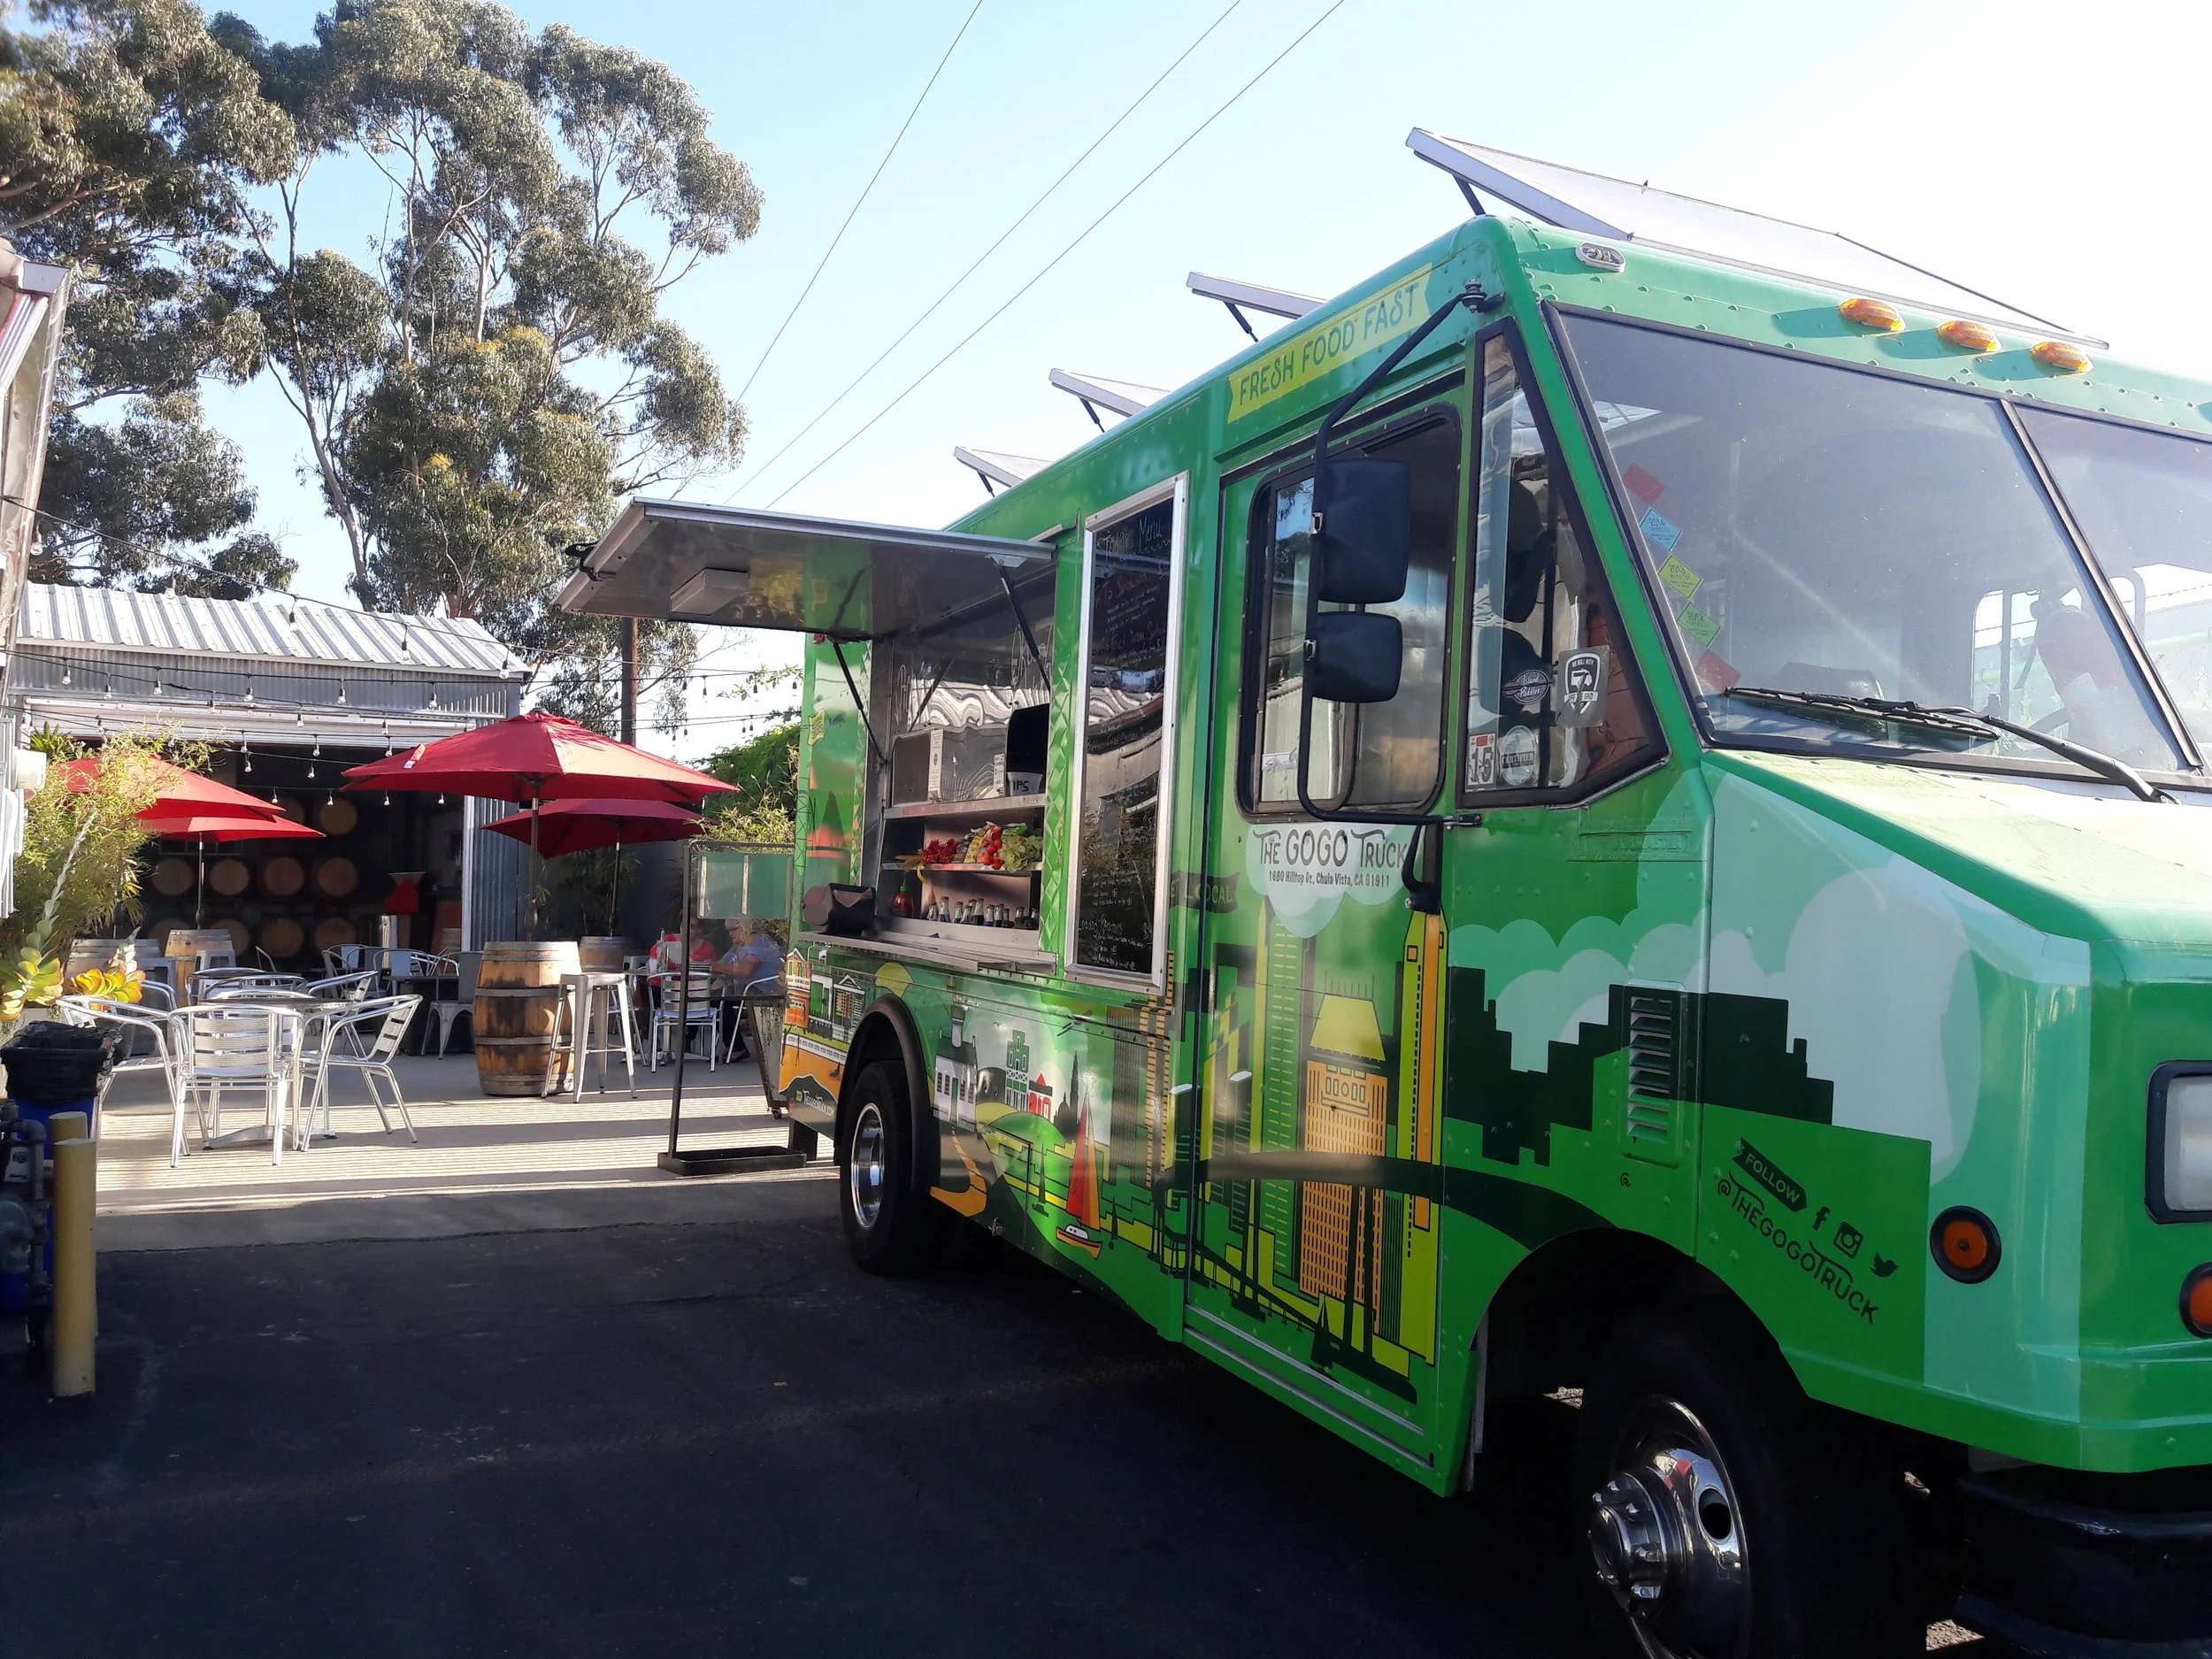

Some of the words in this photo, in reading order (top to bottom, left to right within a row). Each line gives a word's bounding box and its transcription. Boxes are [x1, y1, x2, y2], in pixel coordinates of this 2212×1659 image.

[1239, 350, 1294, 406] FRESH
[1302, 321, 1356, 373] FOOD
[1363, 282, 1419, 341] FAST
[1520, 686, 1541, 698] Paddler
[1523, 672, 1540, 686] Island
[1471, 747, 1494, 783] 15
[1013, 780, 1030, 792] IPS
[1252, 828, 1281, 864] THE
[1286, 828, 1348, 867] GOGO
[1350, 828, 1409, 869] TRUCK
[1269, 870, 1285, 882] 1680
[1285, 870, 1305, 887] Hilltop
[1316, 872, 1333, 885] Chula
[1334, 872, 1352, 887] Vista,
[1354, 873, 1363, 887] CA
[1365, 873, 1390, 887] 91911
[1744, 1153, 1801, 1203] FOLLOW
[1717, 1171, 1879, 1325] @THEGOGOTRUCK
